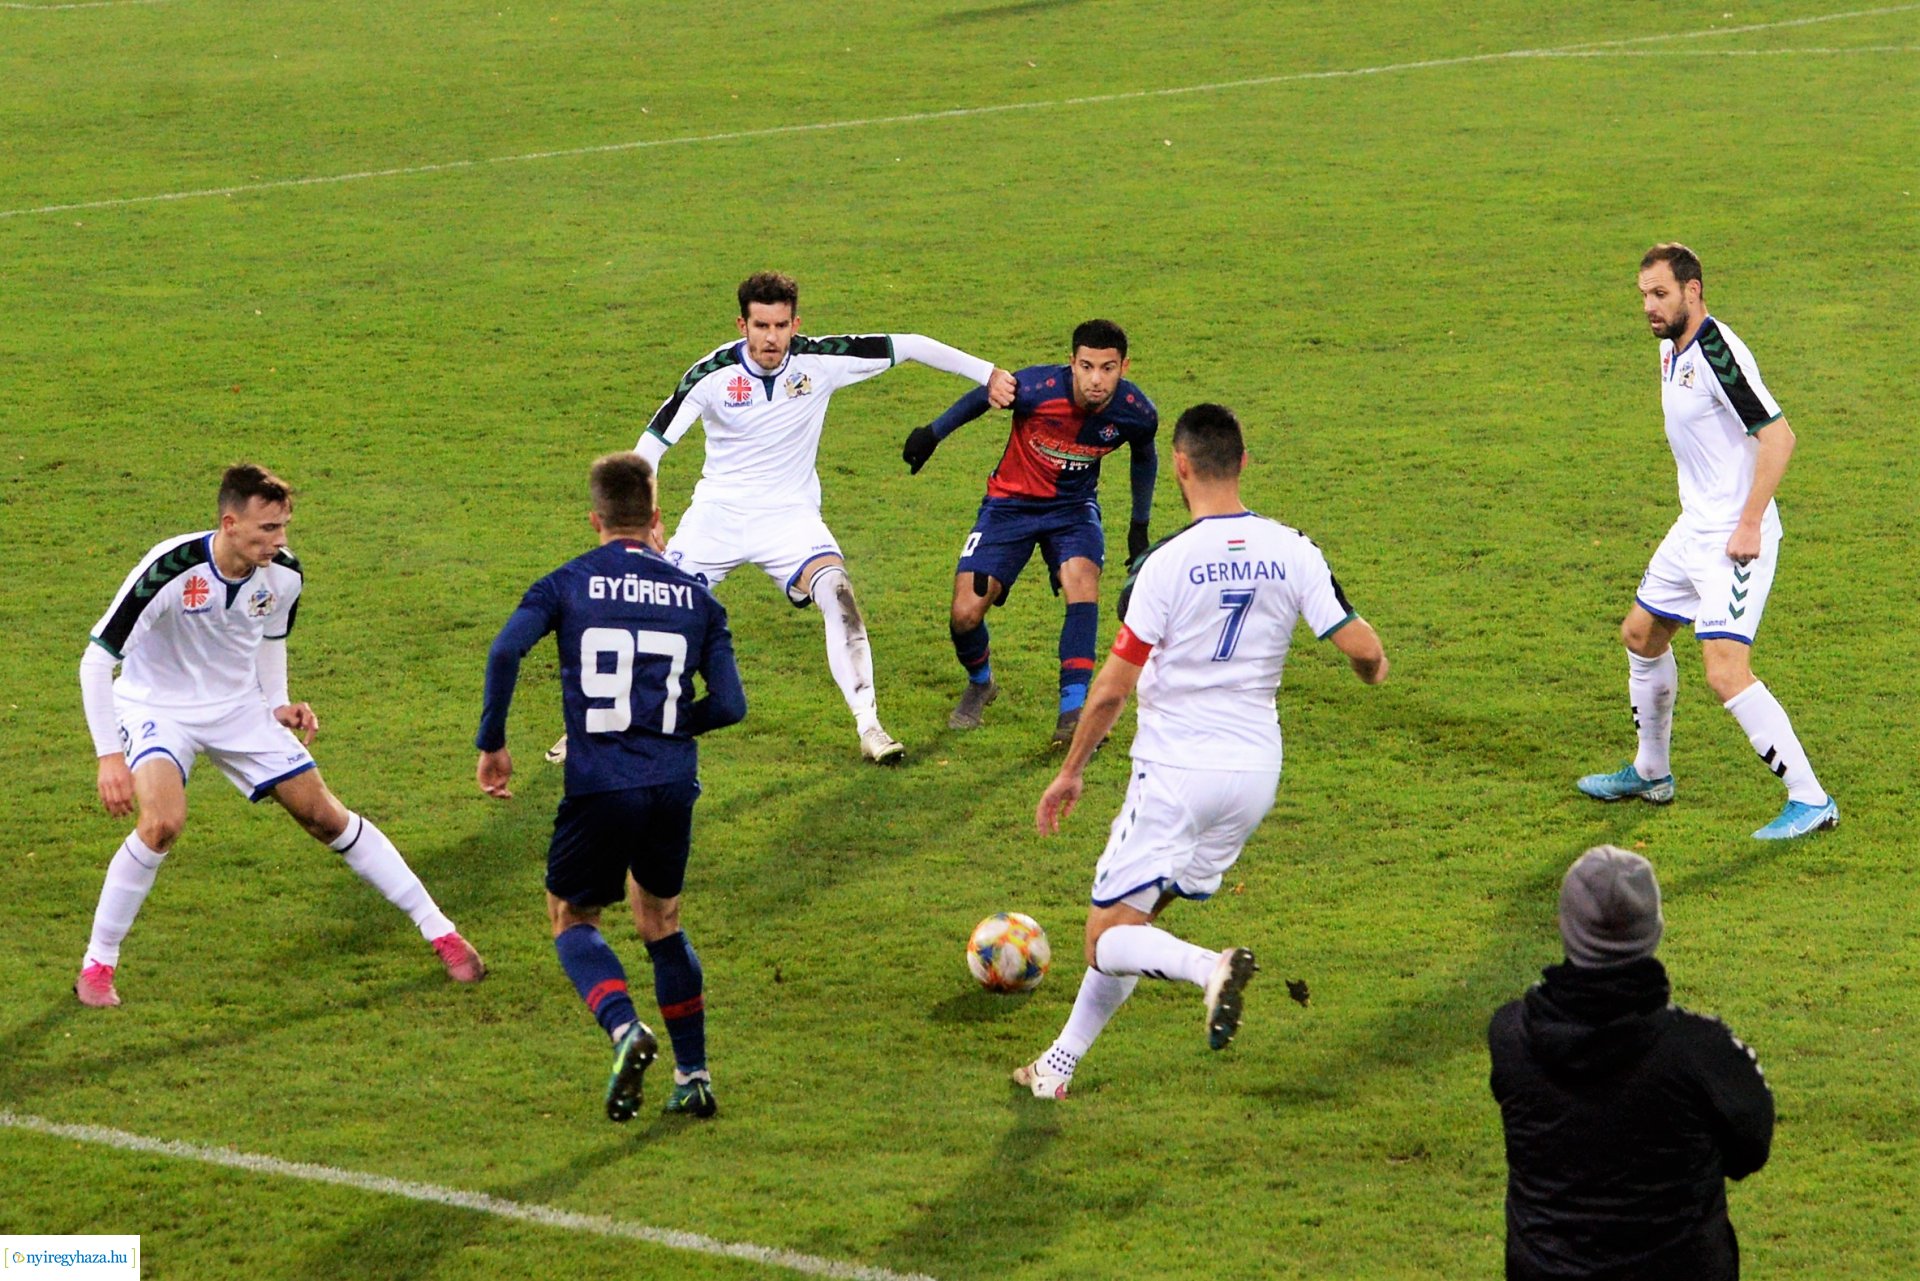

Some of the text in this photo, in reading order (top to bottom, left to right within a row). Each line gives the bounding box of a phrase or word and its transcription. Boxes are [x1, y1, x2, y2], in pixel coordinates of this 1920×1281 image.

[1189, 560, 1287, 585] GERMAN
[589, 573, 694, 610] GYÖRGYI
[1211, 587, 1256, 662] 7
[580, 627, 688, 734] 97
[141, 720, 156, 739] 2
